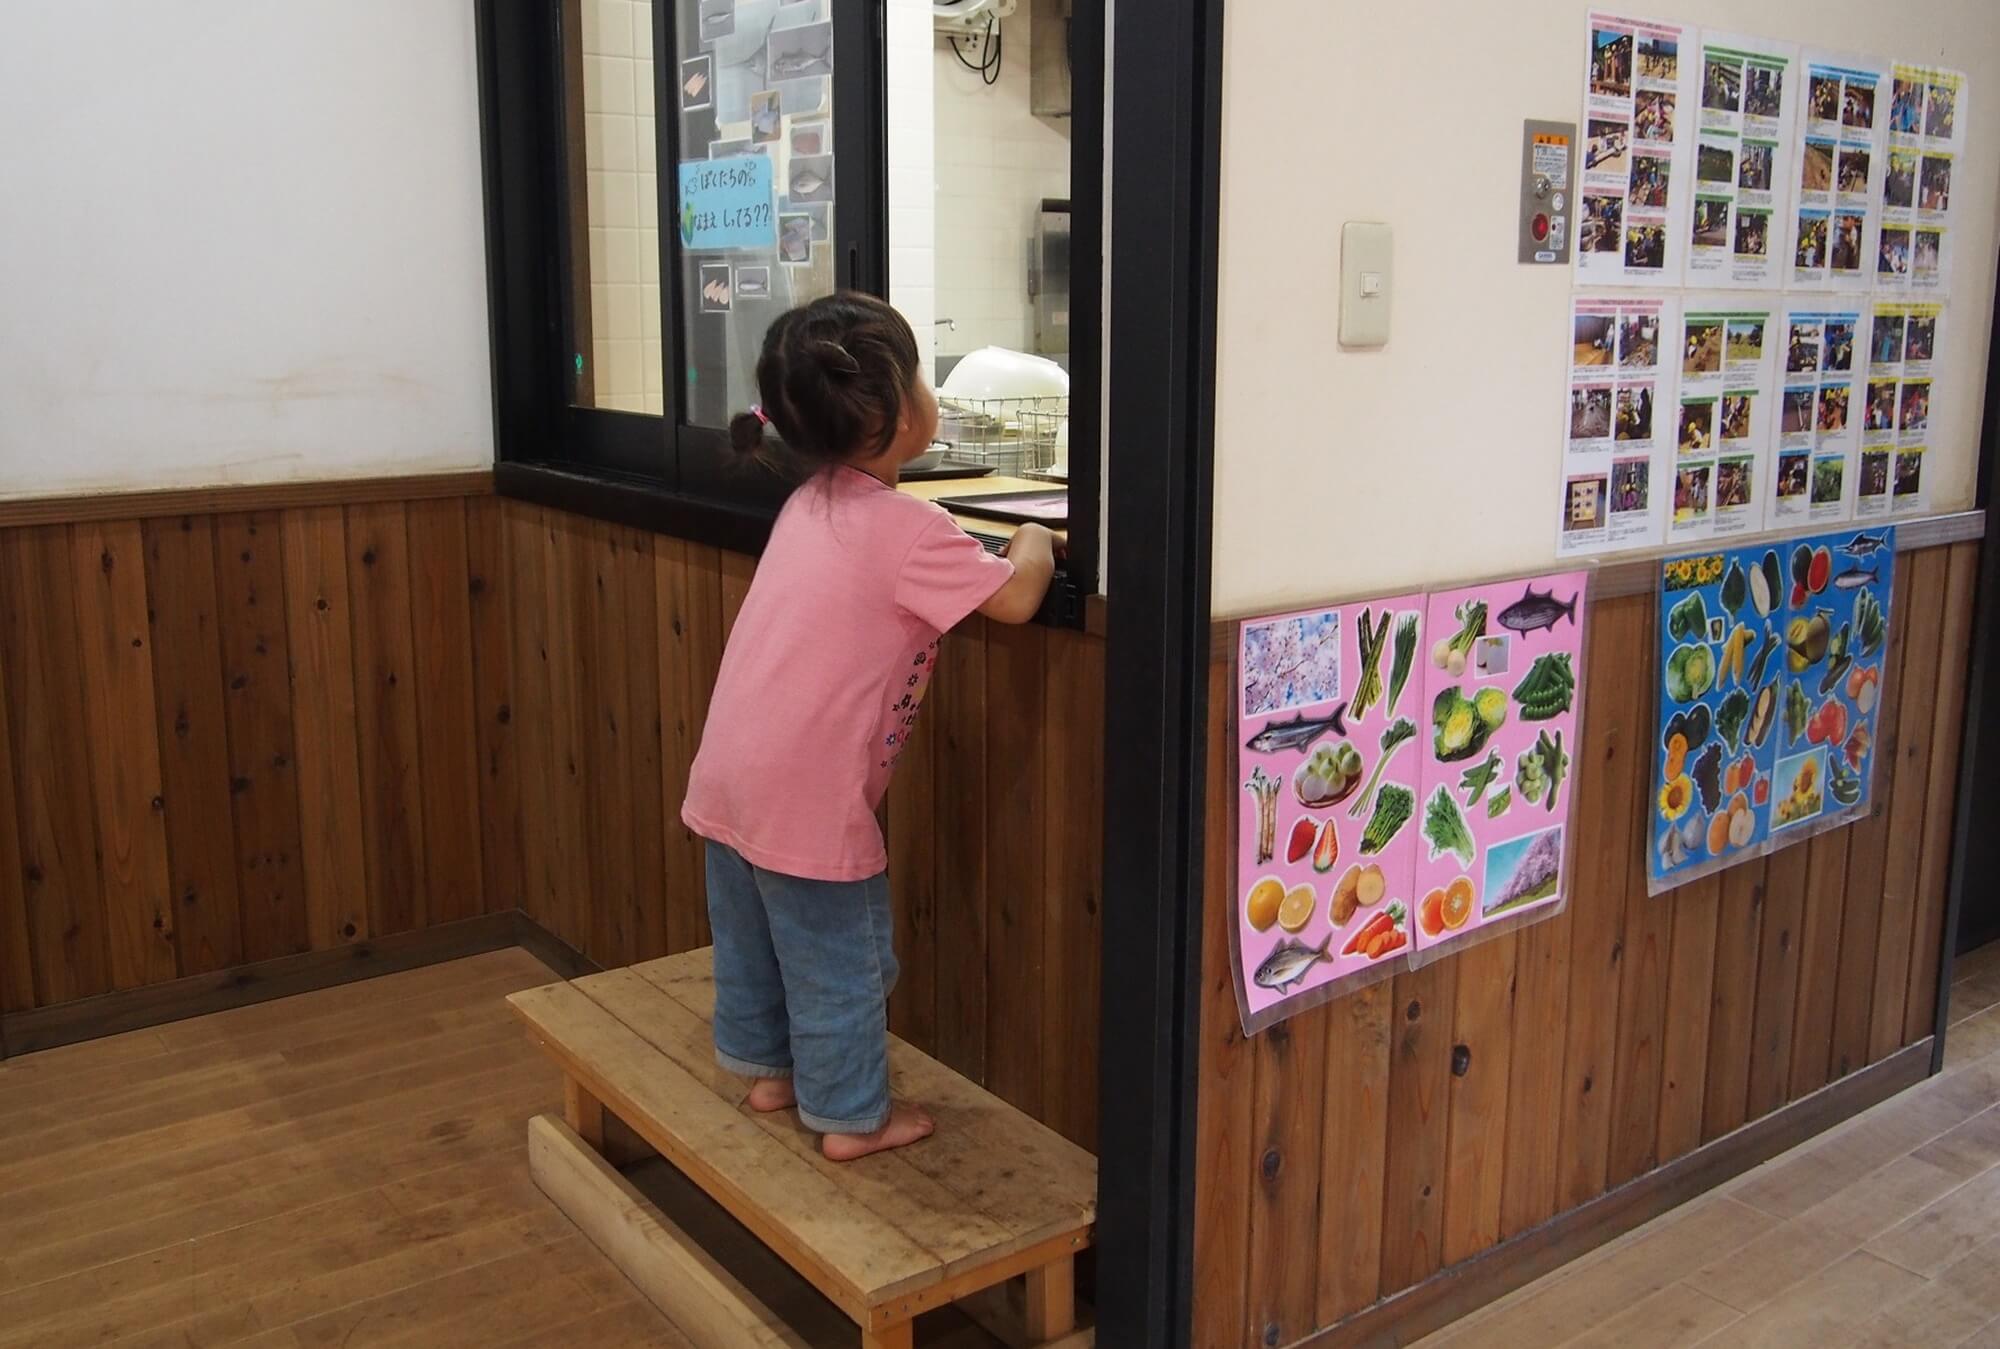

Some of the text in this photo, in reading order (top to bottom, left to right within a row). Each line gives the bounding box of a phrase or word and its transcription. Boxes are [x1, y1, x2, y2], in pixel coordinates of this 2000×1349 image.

[700, 168, 747, 190] ぼくたちの
